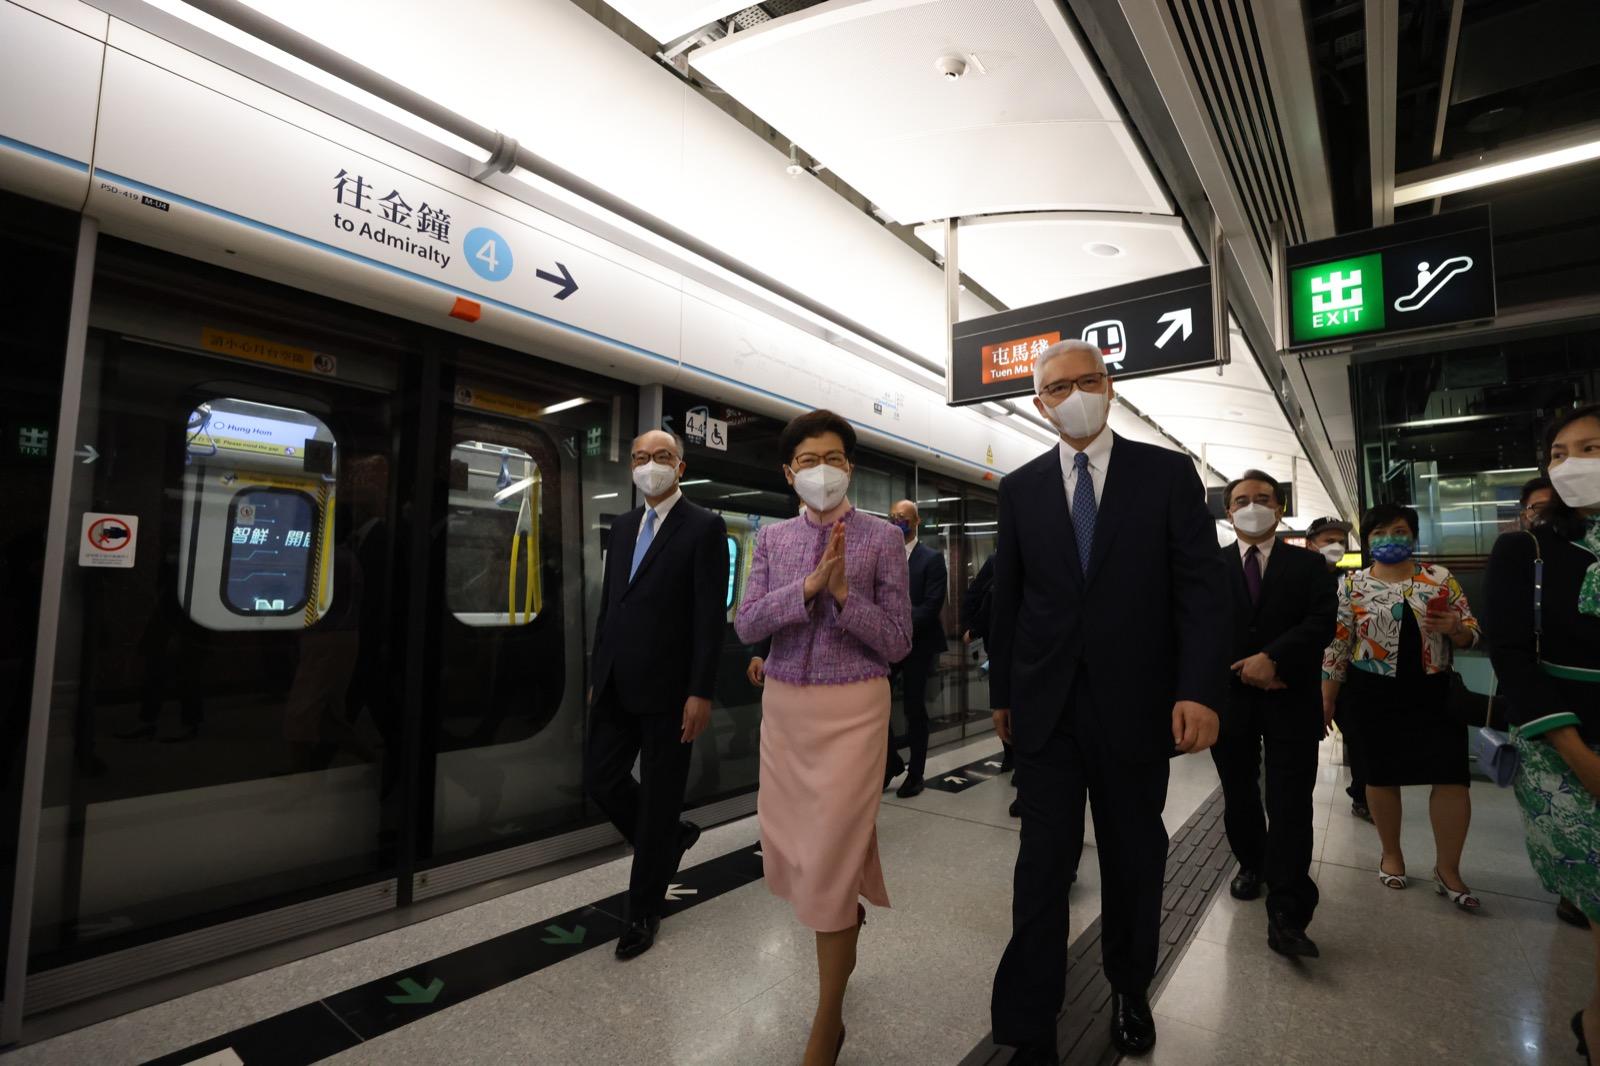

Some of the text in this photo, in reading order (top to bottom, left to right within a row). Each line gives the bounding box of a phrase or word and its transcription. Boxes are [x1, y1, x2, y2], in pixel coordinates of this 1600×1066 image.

[101, 183, 139, 200] PSD-419
[333, 169, 450, 245] 往金鐘
[334, 213, 450, 269] to Admiralty
[476, 239, 499, 272] 4
[1313, 307, 1364, 328] EXIT
[990, 368, 1013, 379] Tuen
[1014, 365, 1028, 374] Ma
[227, 424, 273, 437] Hung Hom
[686, 416, 704, 435] 4-4
